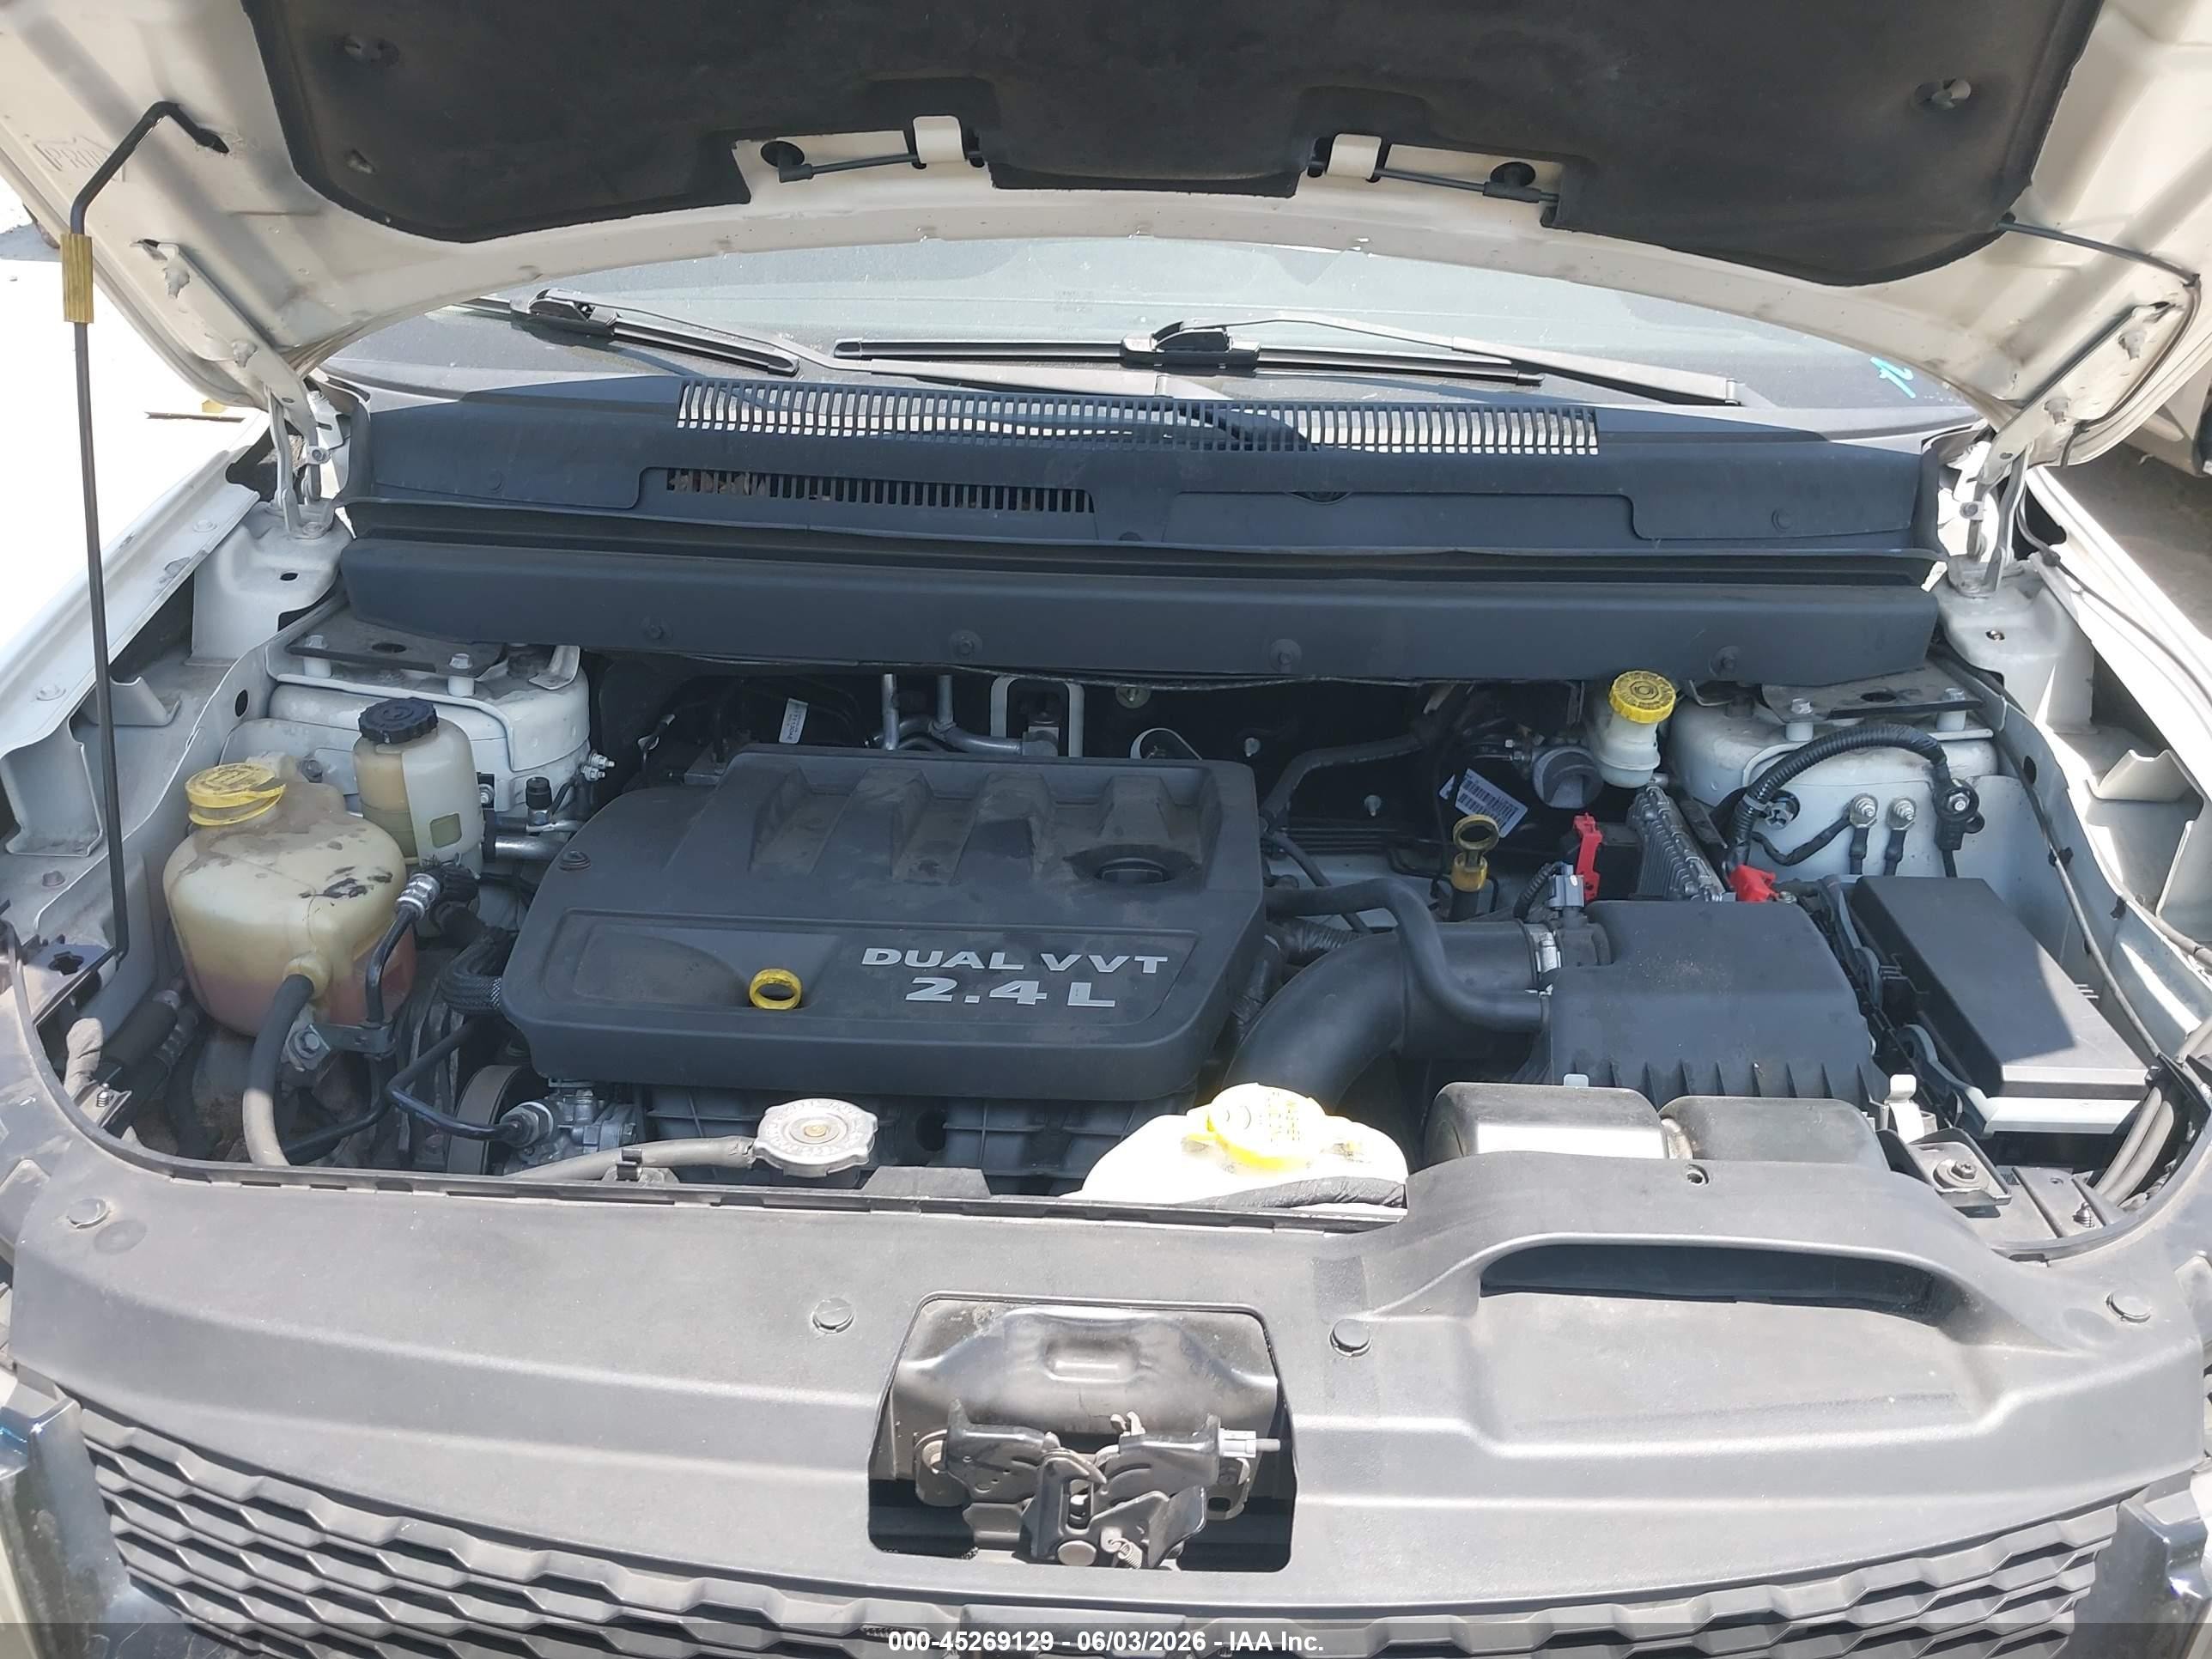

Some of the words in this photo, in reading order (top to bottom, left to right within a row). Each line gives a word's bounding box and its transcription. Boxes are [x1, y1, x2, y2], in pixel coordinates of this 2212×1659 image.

[861, 947, 1024, 970] DUAL
[1040, 952, 1169, 974] VVT
[905, 976, 1048, 1006] 2.4
